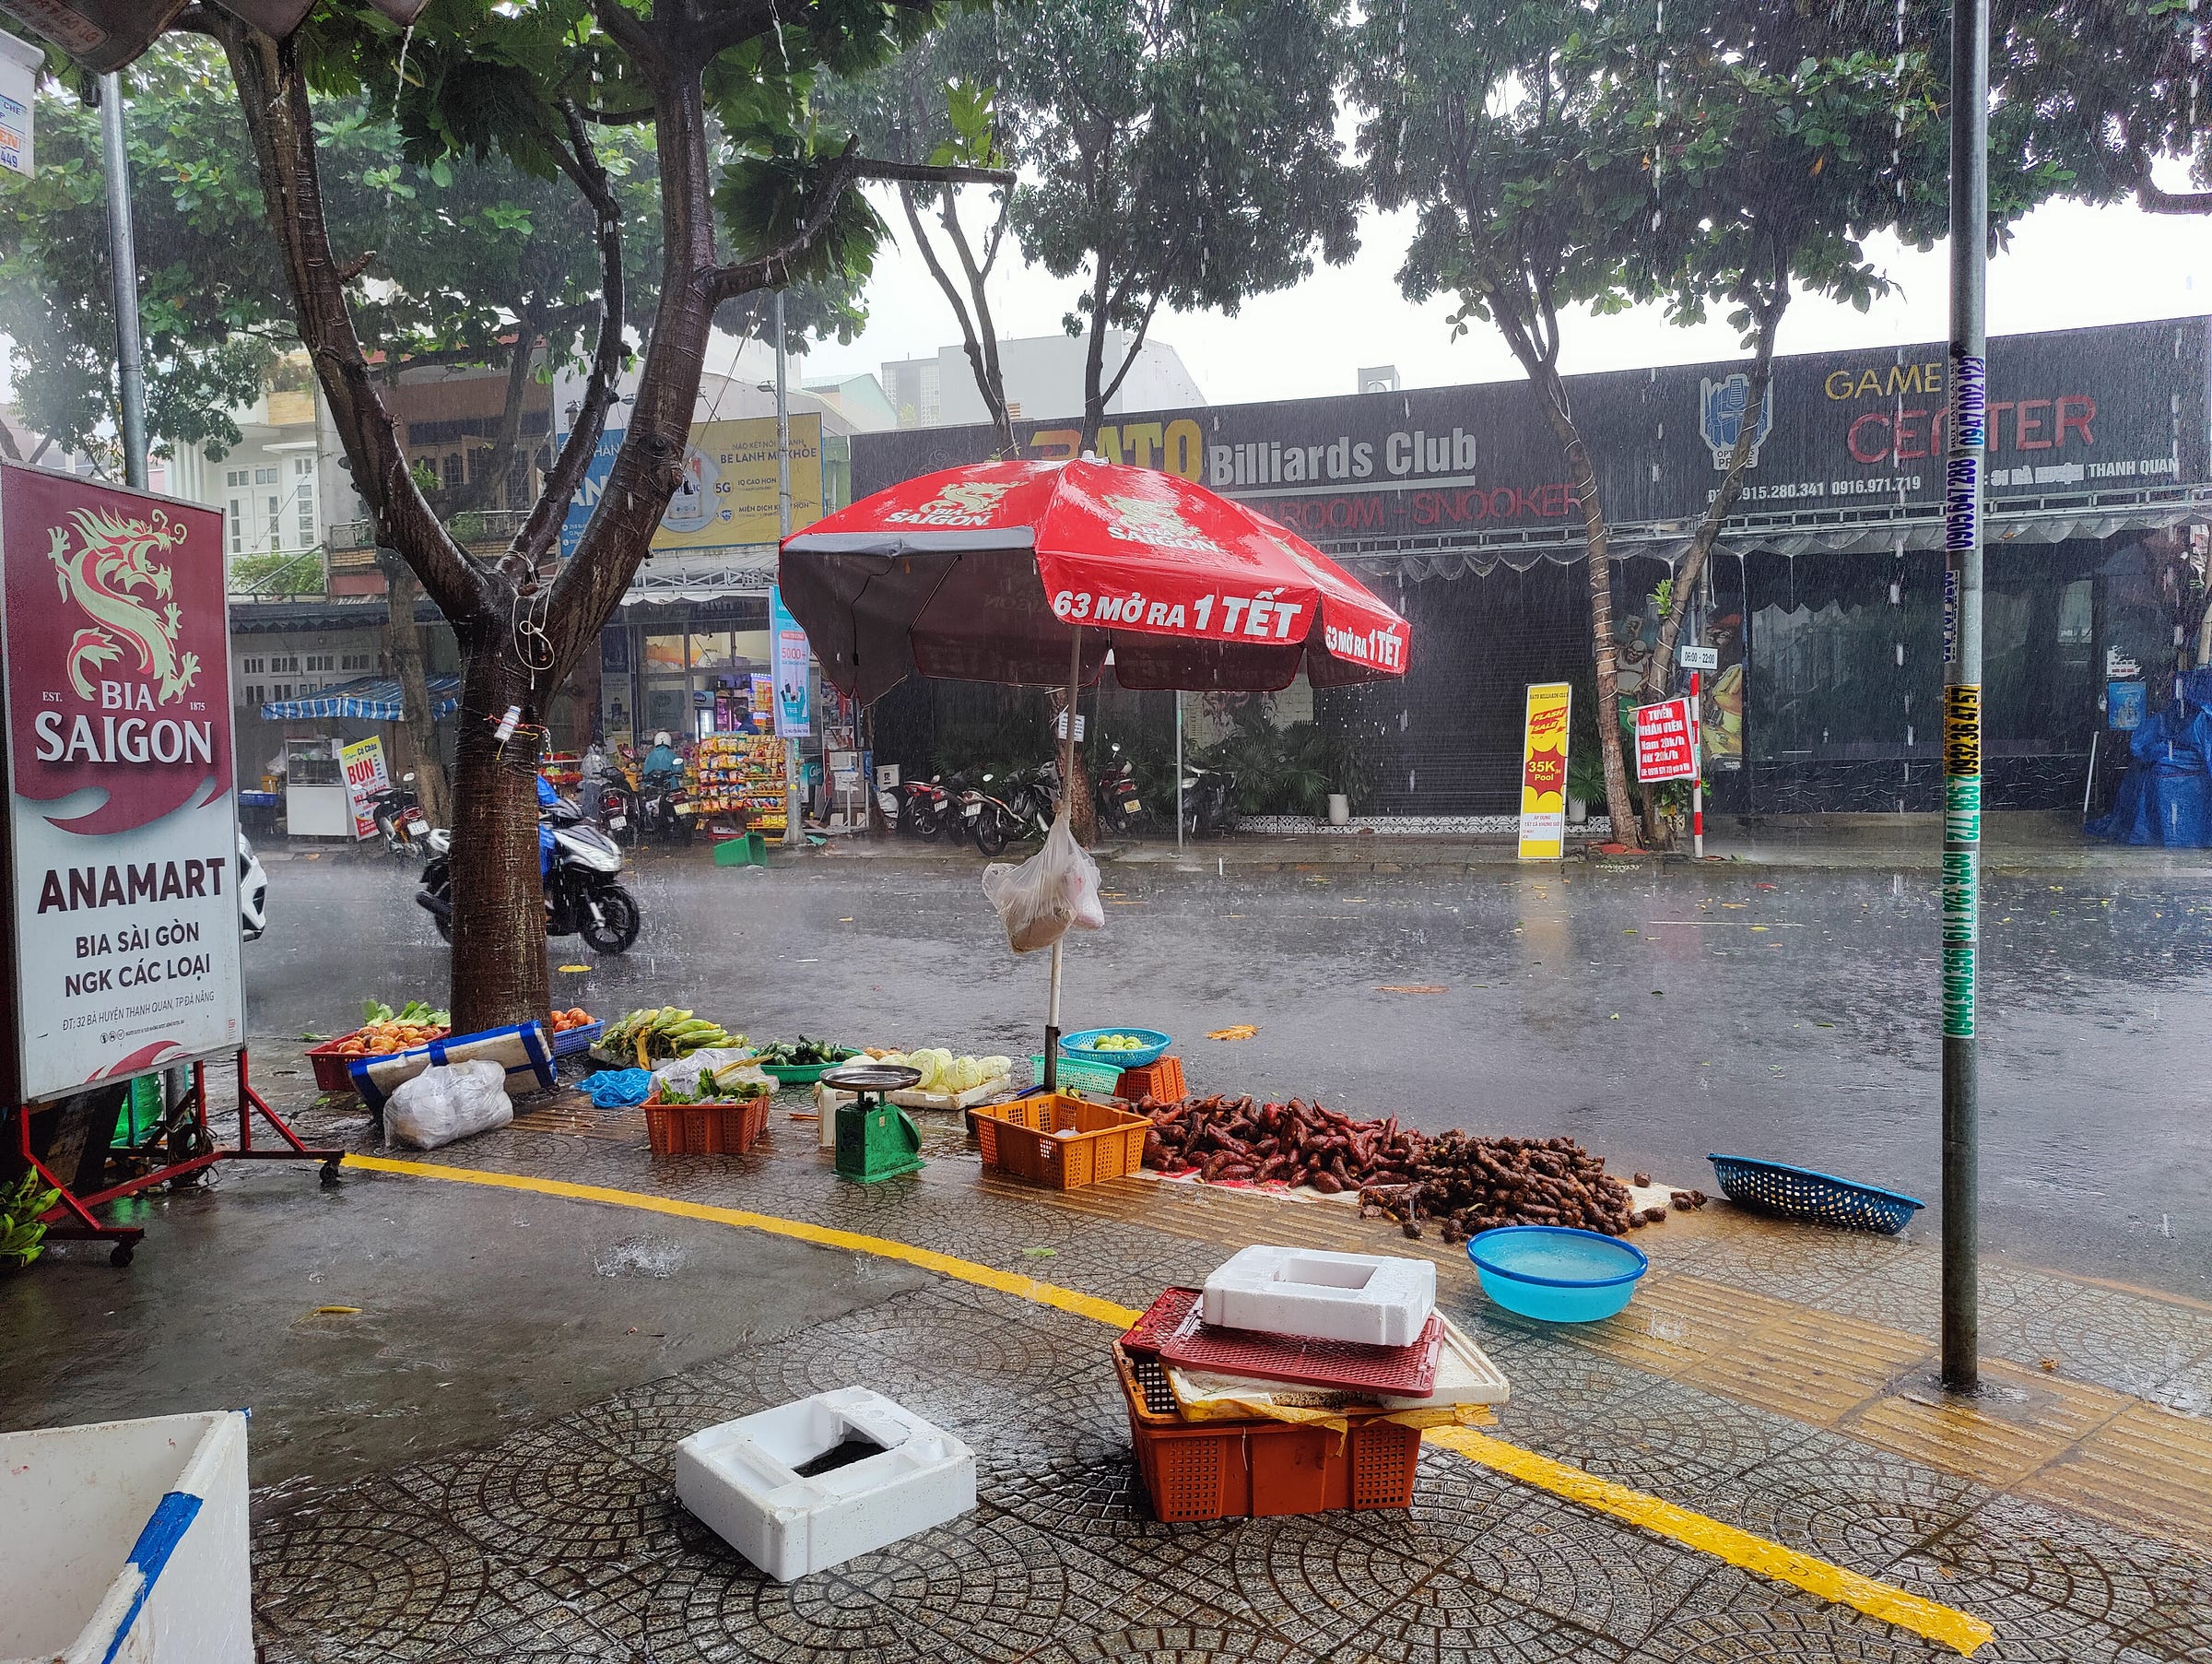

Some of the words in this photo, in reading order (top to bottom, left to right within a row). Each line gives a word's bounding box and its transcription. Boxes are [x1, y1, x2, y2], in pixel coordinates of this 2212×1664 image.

[1825, 362, 1942, 400] GAME
[1209, 436, 1373, 486] Billiards
[1386, 428, 1476, 476] Club
[1717, 449, 1754, 457] OPTS
[1718, 456, 1753, 467] PRE
[2088, 461, 2136, 478] THANH
[2140, 458, 2179, 475] QUAN
[715, 482, 731, 493] 5G
[1832, 476, 1921, 495] 0916.971.719
[884, 512, 993, 525] SAIGON
[1413, 483, 1582, 525] SNOOKER
[1946, 459, 1976, 549] 0905.647.288
[1107, 526, 1222, 553] SAIGON
[1053, 590, 1091, 619] 63
[1094, 592, 1146, 623] MỞ
[1147, 602, 1185, 628] RA
[1194, 594, 1215, 630] 1
[1221, 587, 1302, 638] TẾT
[1325, 625, 1337, 651] 63
[1338, 626, 1354, 655] MỞ
[1354, 635, 1368, 659] RA
[1369, 629, 1376, 661] 1
[1377, 622, 1402, 667] TẾT
[1685, 652, 1697, 662] 06:00
[1702, 653, 1715, 664] 22:00
[42, 690, 64, 702] EST.
[190, 701, 206, 712] 1875
[100, 680, 156, 712] BIA
[1534, 709, 1564, 722] FLASH
[1534, 721, 1558, 732] SALE
[35, 710, 213, 764] SAIGON
[347, 758, 375, 785] BÚN
[37, 857, 226, 915] ANAMART
[76, 934, 112, 959] BIA
[118, 924, 149, 952] SÀI
[156, 918, 199, 947] GÒN
[65, 969, 112, 997] NGK
[119, 958, 161, 987] CÁC
[167, 953, 210, 982] LOẠI
[63, 1019, 76, 1031] ĐT:
[76, 1016, 86, 1029] 32
[87, 1010, 97, 1025] BÀ
[99, 1007, 124, 1023] HUYỆN
[125, 1004, 150, 1018] THANH
[151, 998, 173, 1014] QUAN,
[175, 997, 184, 1009] TP
[184, 995, 194, 1007] ĐÀ
